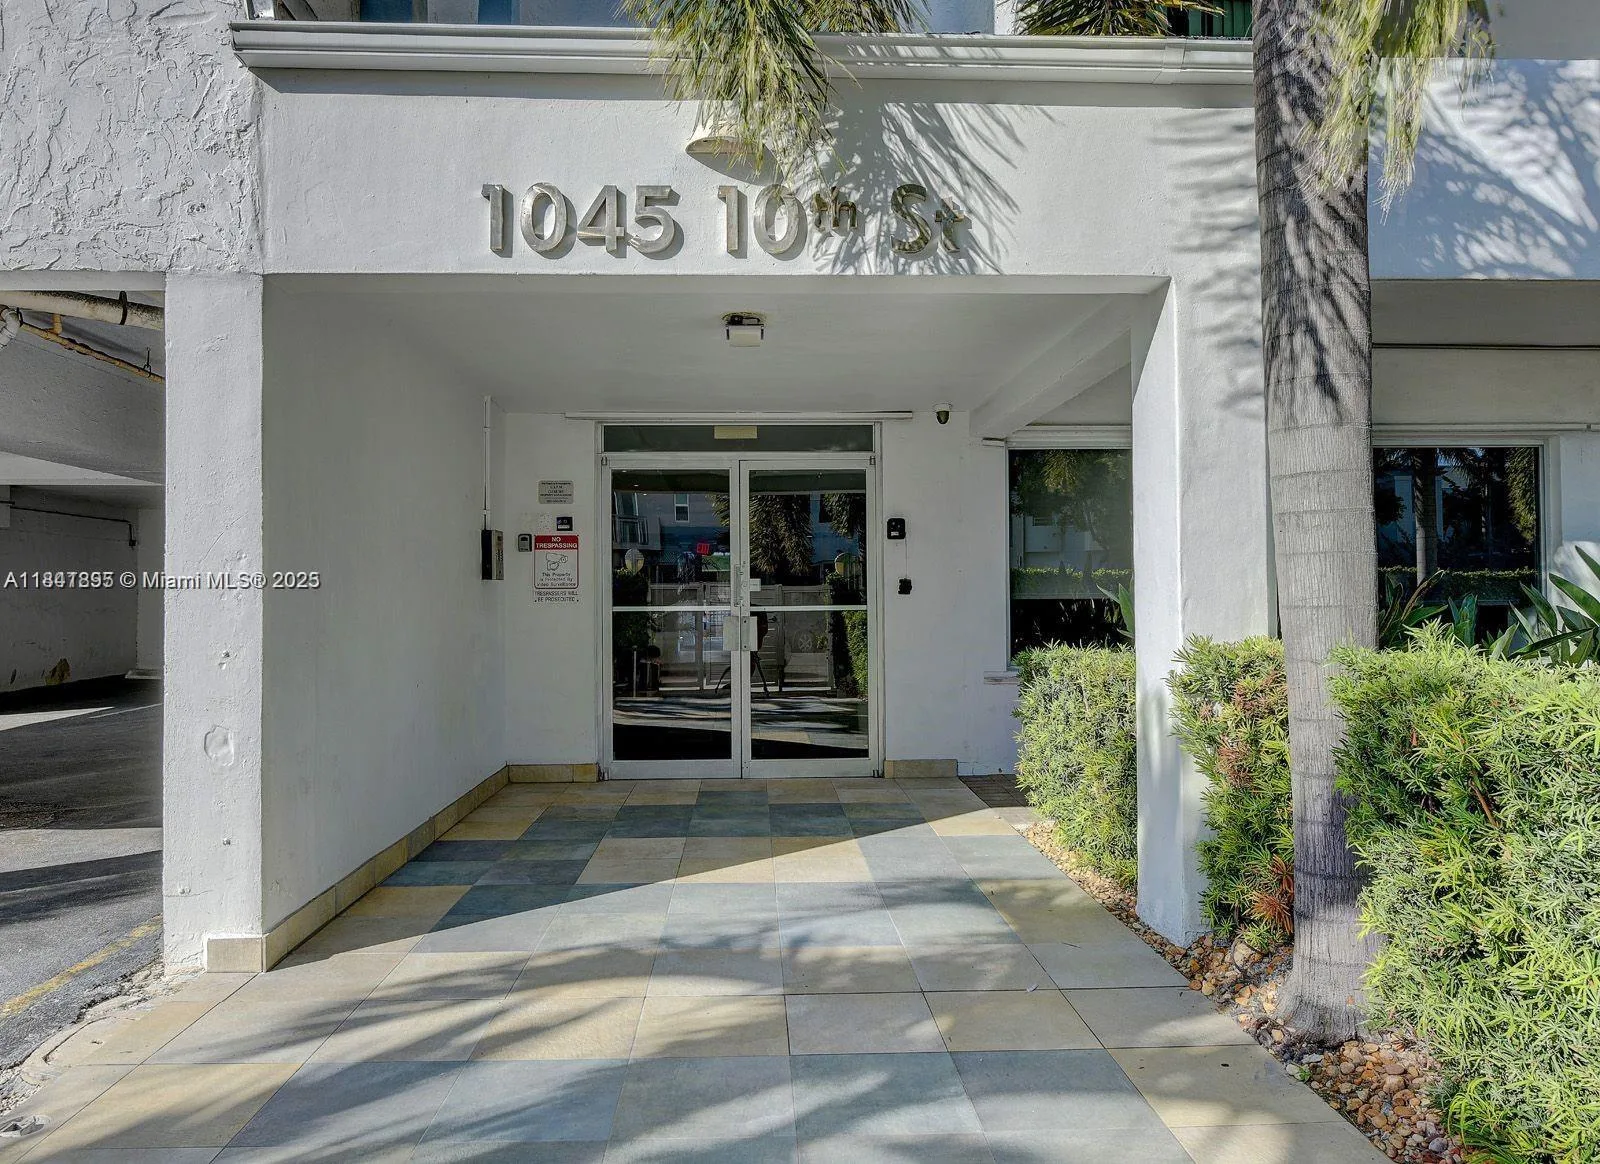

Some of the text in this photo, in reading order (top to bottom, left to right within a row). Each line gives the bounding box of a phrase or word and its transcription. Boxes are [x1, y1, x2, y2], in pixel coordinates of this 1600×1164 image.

[481, 182, 965, 255] 1045 10th St
